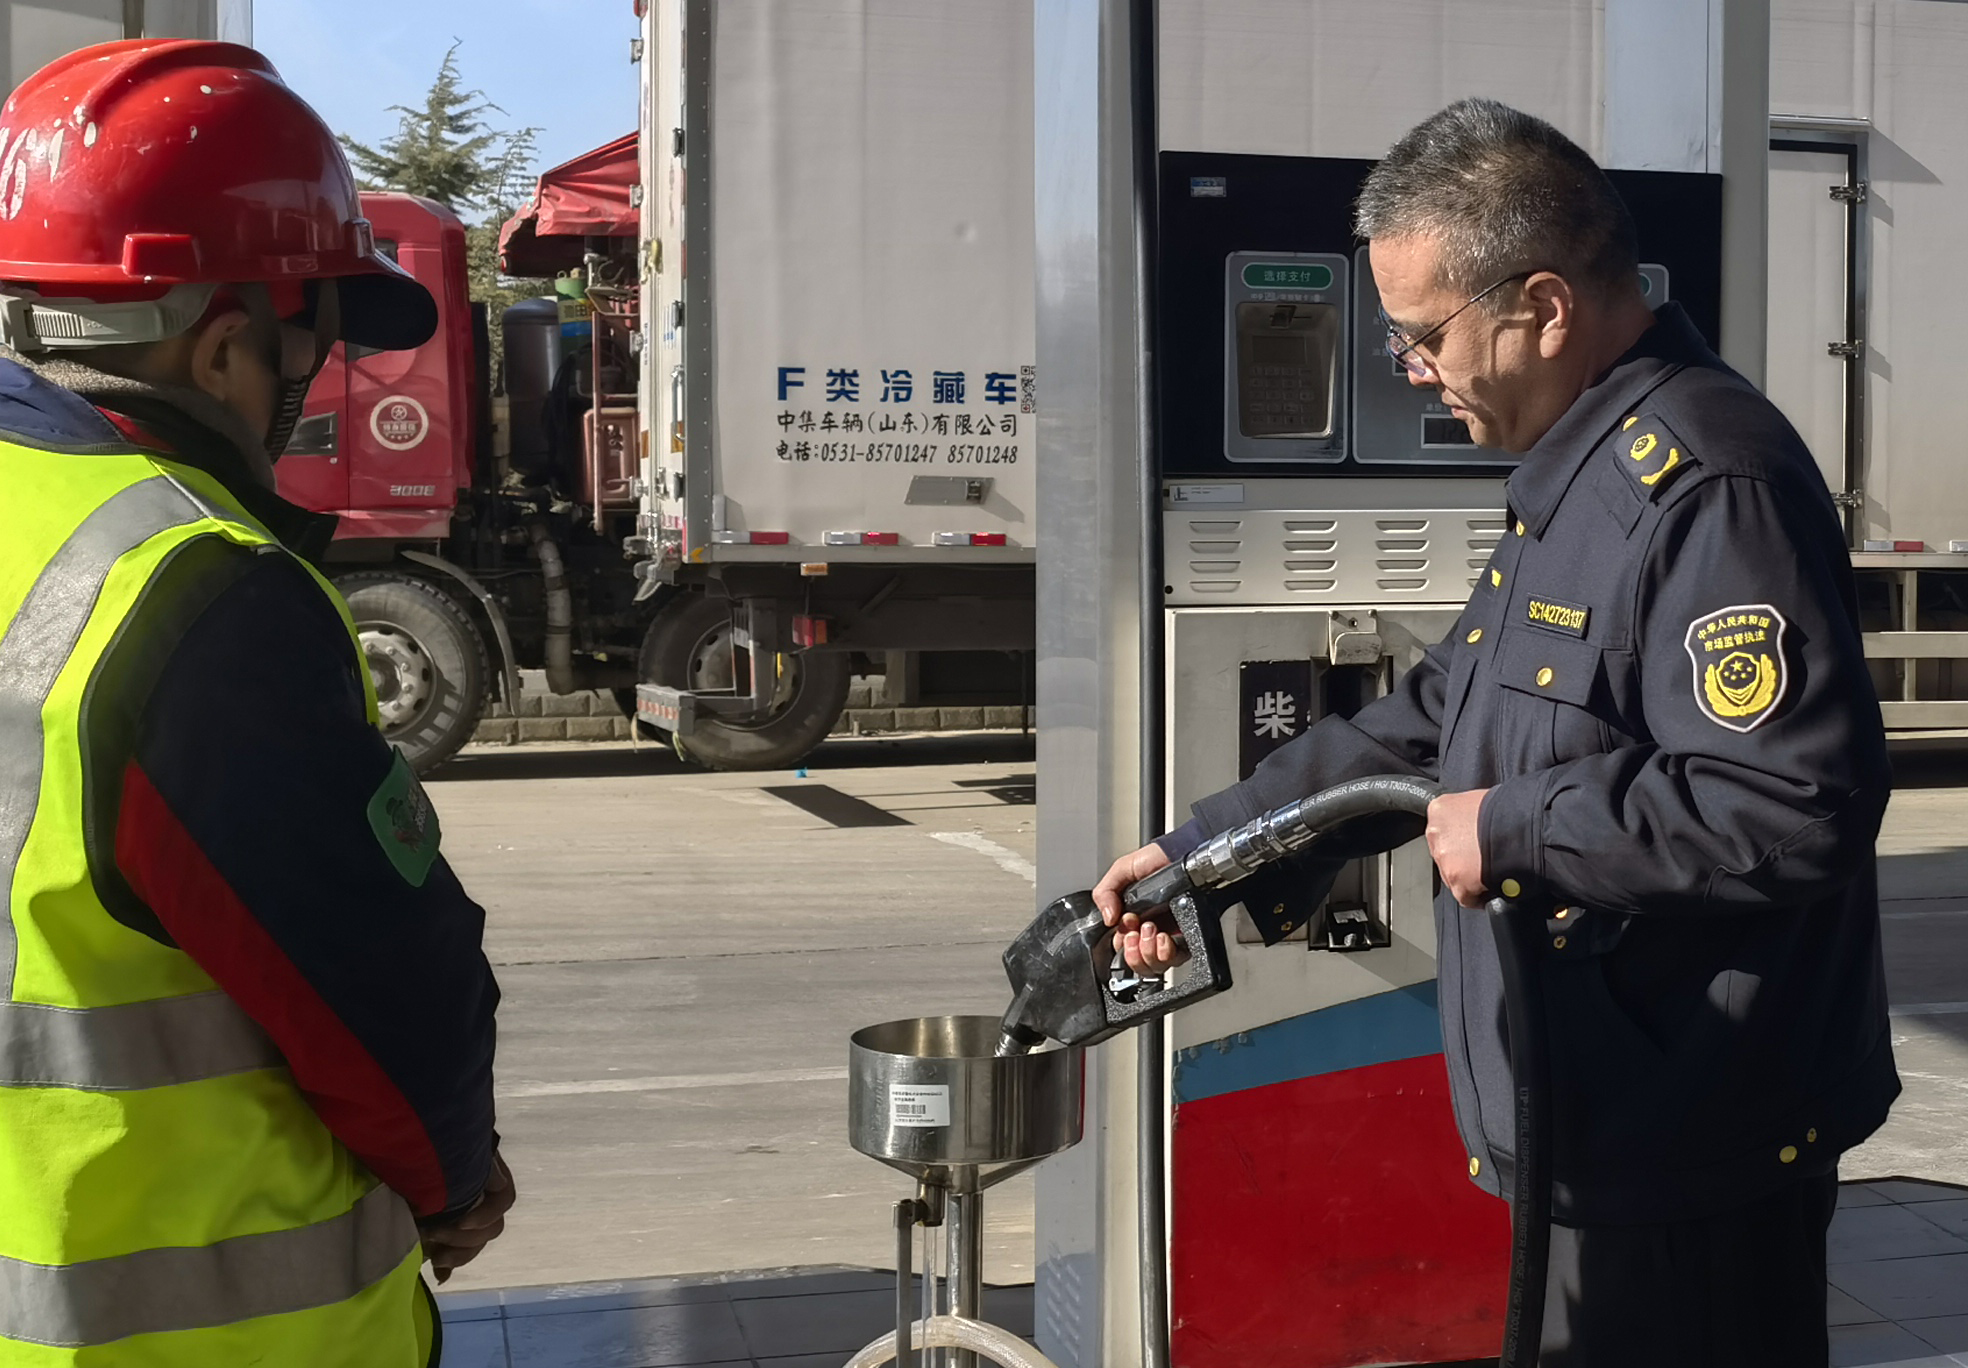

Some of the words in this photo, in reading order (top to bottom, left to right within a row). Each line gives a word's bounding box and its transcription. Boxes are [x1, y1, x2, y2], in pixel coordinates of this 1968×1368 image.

[1264, 271, 1311, 282] 选择支付
[777, 366, 1017, 405] F类冷藏车
[776, 410, 1018, 437] 中集车辆(山东)有限公司
[947, 443, 1018, 464] 85701248
[1697, 614, 1771, 640] 中华人民共和国
[1704, 629, 1767, 652] 市场监督执法
[1253, 691, 1296, 739] 柴
